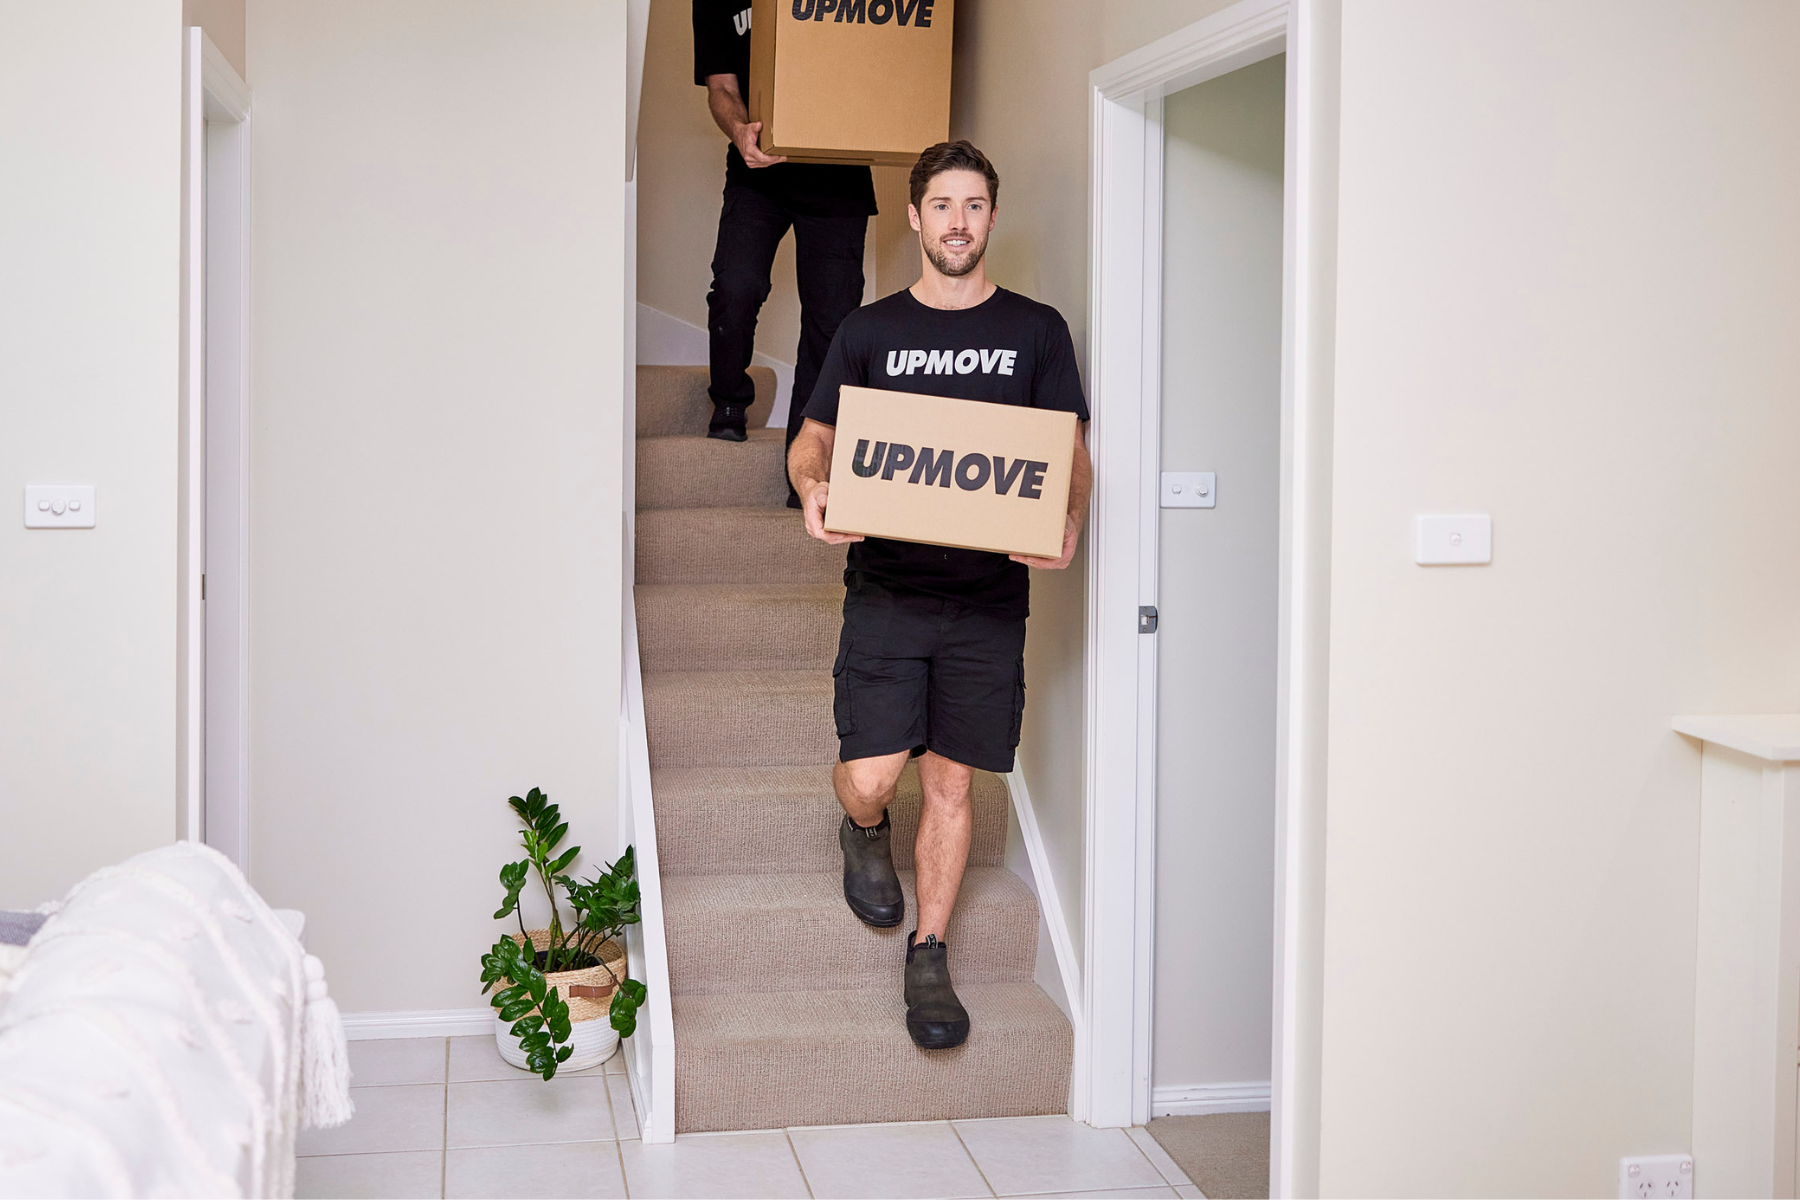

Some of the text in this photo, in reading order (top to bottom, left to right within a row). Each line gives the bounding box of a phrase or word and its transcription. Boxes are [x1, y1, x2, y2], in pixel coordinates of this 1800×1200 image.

[792, 0, 935, 28] UPMOVE
[886, 349, 1018, 376] UPMOVE
[851, 439, 1049, 500] UPMOVE
